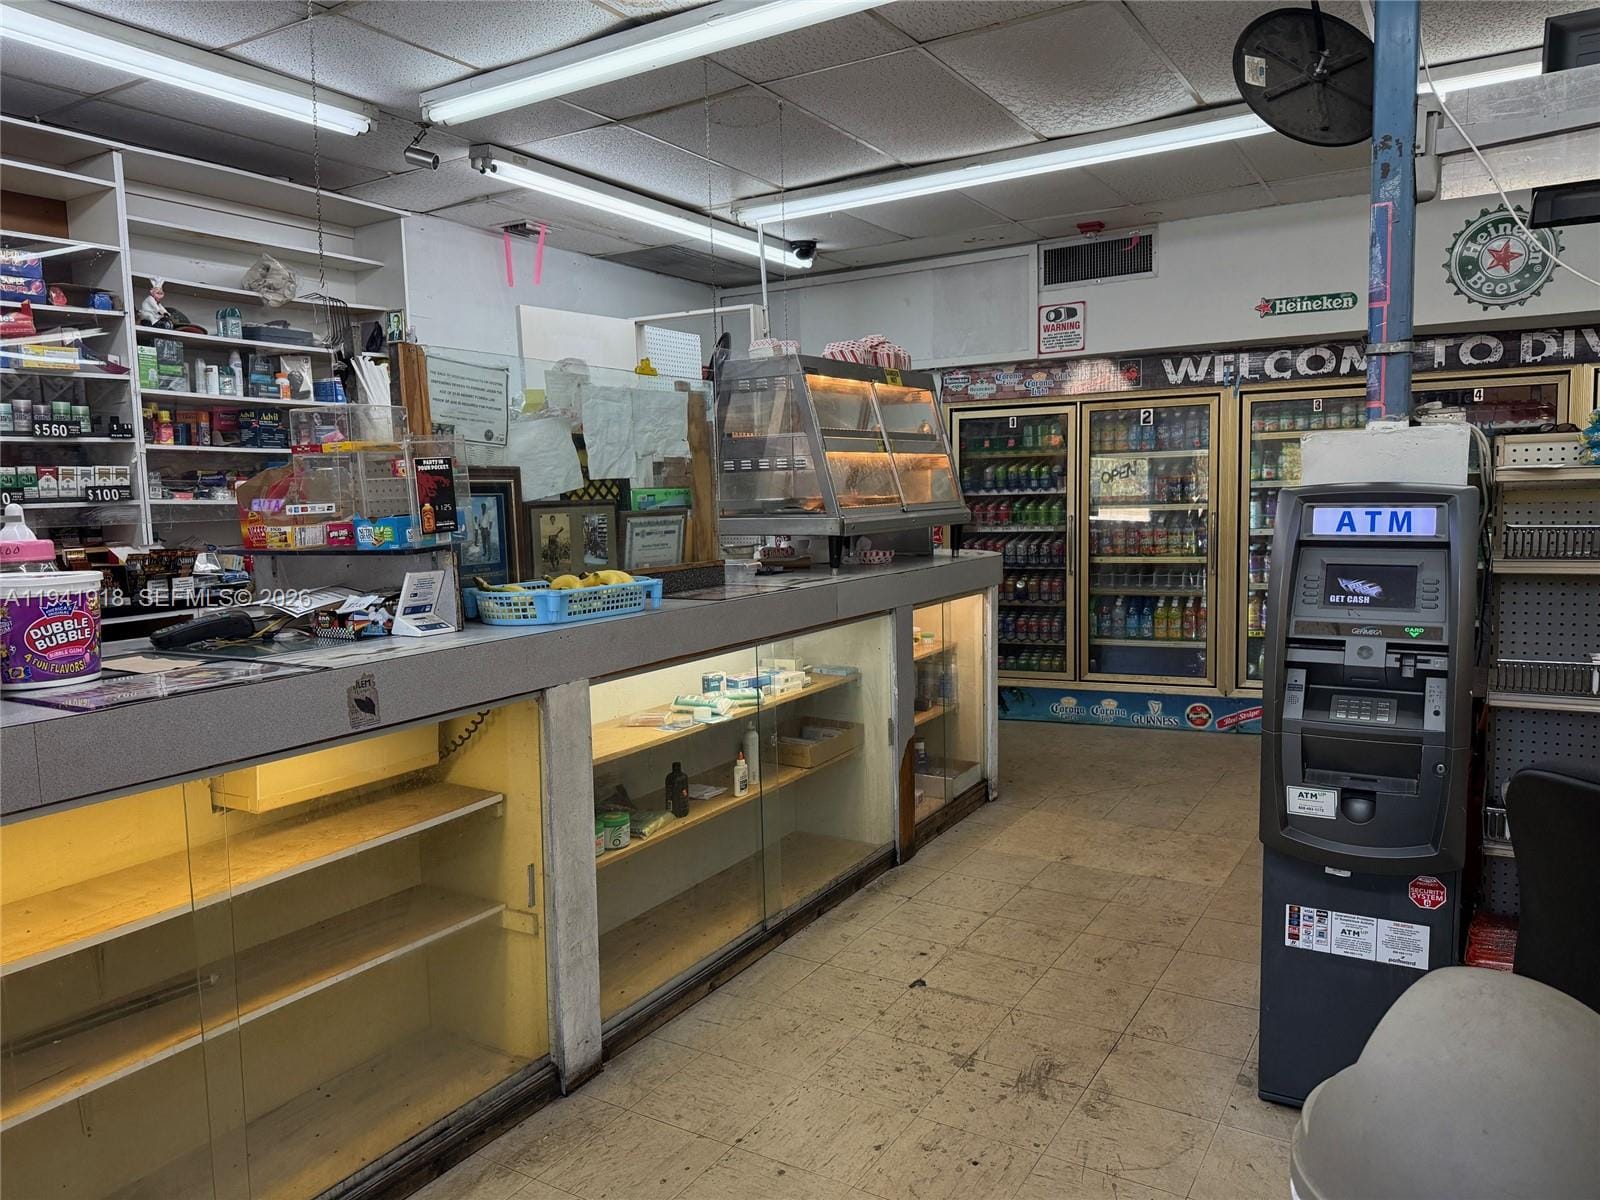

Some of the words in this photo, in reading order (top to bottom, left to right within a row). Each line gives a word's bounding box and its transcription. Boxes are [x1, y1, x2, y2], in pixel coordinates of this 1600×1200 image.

[1467, 271, 1521, 295] Beer
[1275, 297, 1353, 314] Heineken
[1043, 321, 1081, 333] WARNING
[1161, 345, 1367, 386] WELCOM
[1433, 335, 1504, 369] TO
[995, 372, 1023, 382] Corona
[1024, 380, 1053, 391] Corona
[1031, 388, 1048, 397] Light
[1475, 389, 1482, 400] 4
[1314, 401, 1321, 411] 3
[261, 412, 278, 421] Advil
[1142, 411, 1153, 424] 2
[1101, 461, 1136, 484] OPEN
[1335, 511, 1412, 533] ATM
[1329, 595, 1345, 603] GET
[1346, 595, 1370, 604] CASH
[29, 617, 89, 640] DUBBLE
[34, 629, 92, 651] BUBBLE
[24, 653, 33, 662] 4
[32, 658, 49, 671] FUN
[50, 657, 87, 674] FLAVORS!
[1050, 703, 1085, 715] Corona
[1090, 705, 1127, 717] Corona
[1239, 710, 1261, 720] Stripe
[1130, 714, 1180, 727] GUINNESS
[1298, 791, 1318, 800] ATM
[1411, 887, 1445, 895] SECURITY
[1411, 892, 1443, 901] SYSTEM
[1340, 929, 1360, 937] ATM
